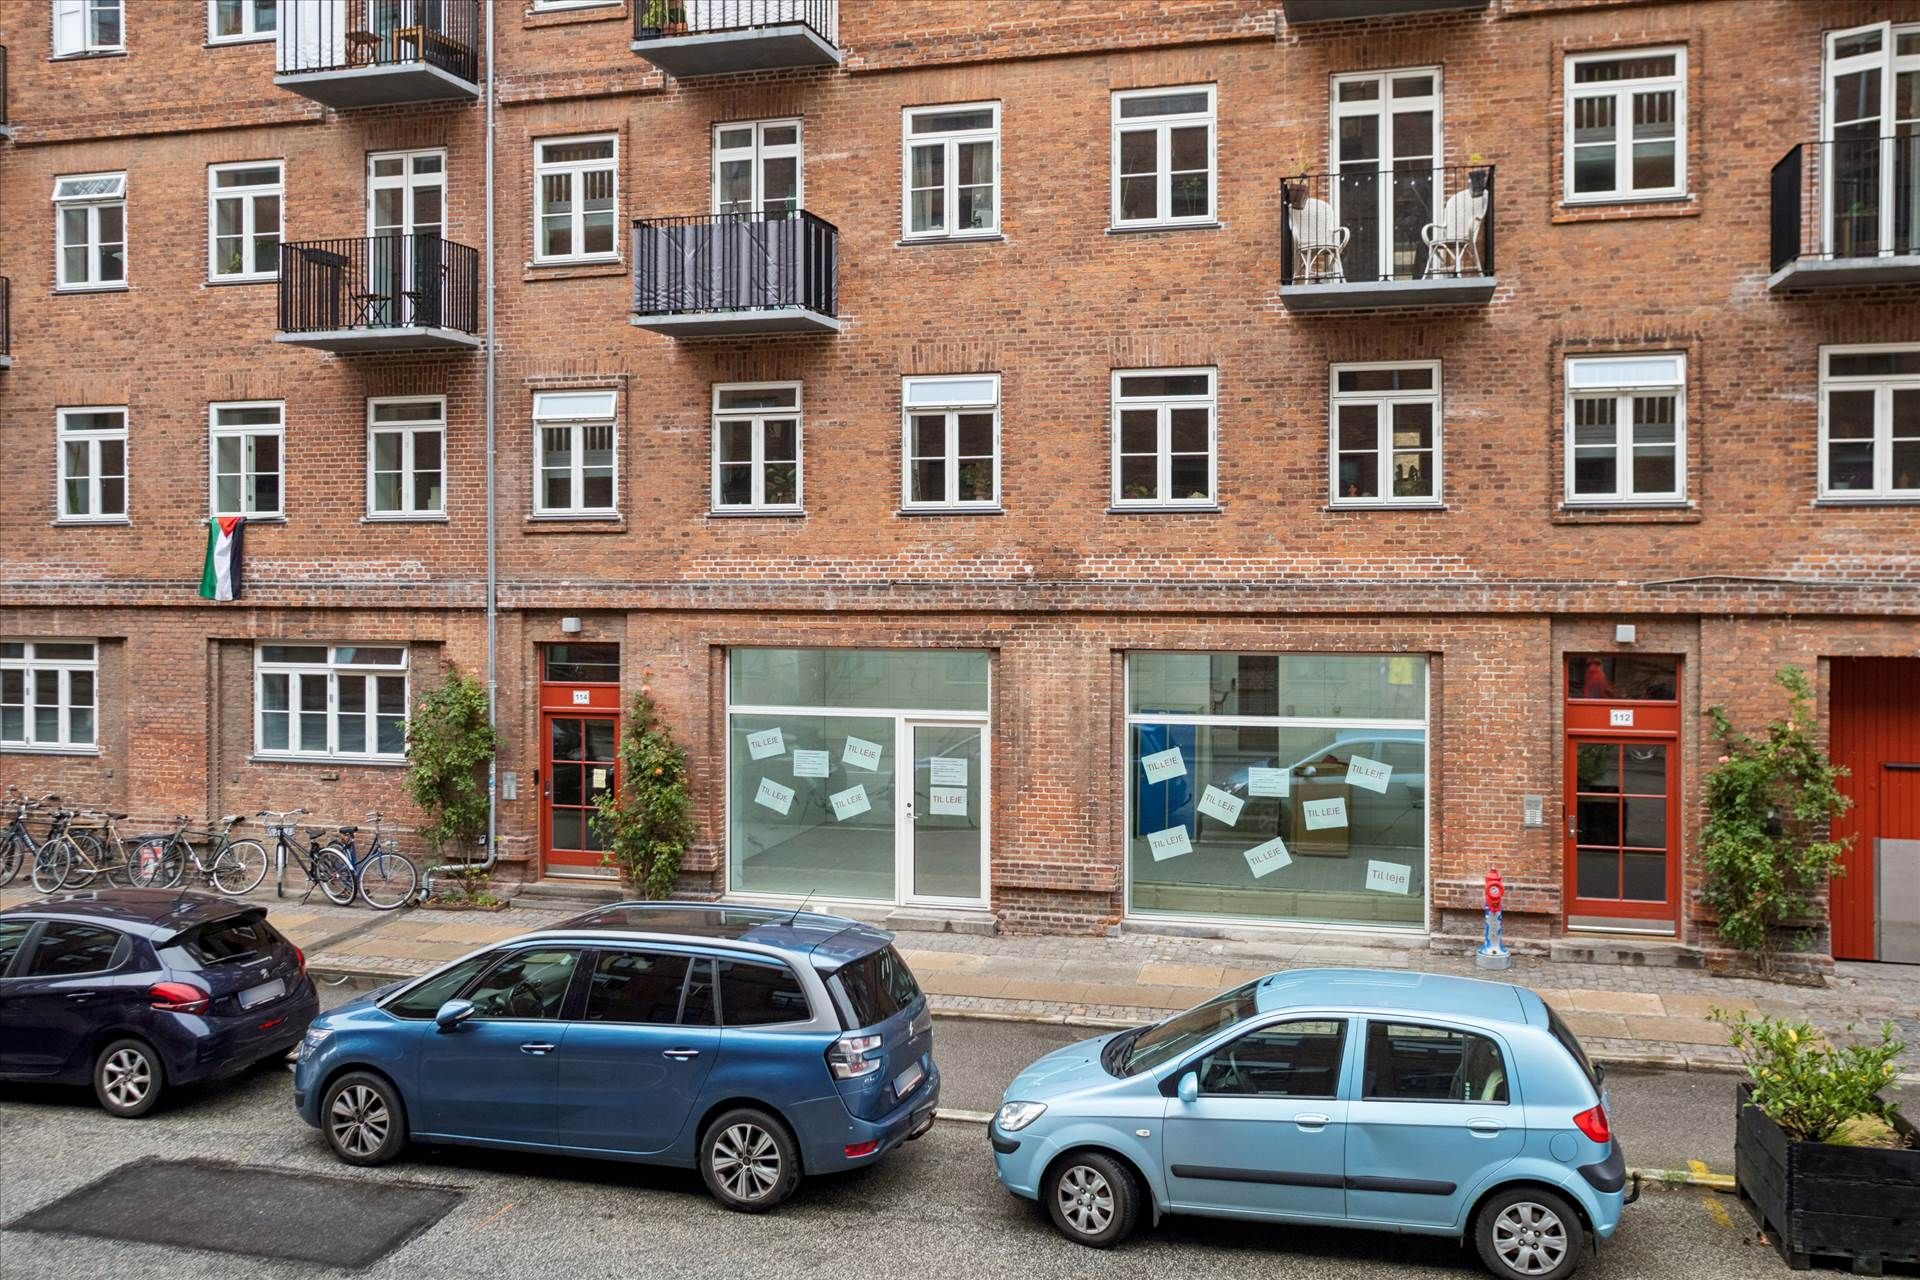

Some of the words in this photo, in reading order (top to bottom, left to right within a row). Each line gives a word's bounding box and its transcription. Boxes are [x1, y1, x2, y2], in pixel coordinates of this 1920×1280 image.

[763, 736, 778, 746] LEJE
[848, 744, 858, 754] TIL
[860, 748, 876, 758] LEJE
[1148, 763, 1159, 771] TIL
[1160, 756, 1177, 768] LEJE
[1352, 764, 1363, 774] TIL
[1365, 768, 1384, 780] LEJE
[762, 786, 772, 795] TIL
[772, 790, 788, 801] LEJE
[835, 800, 845, 808] TIL
[846, 793, 864, 804] LEJE
[933, 796, 944, 804] TIL
[946, 796, 962, 804] LEJE
[1206, 794, 1216, 804] TIL
[1218, 800, 1235, 813] LEJE
[1308, 809, 1320, 817] TIL
[1322, 807, 1340, 816] LEJE
[1153, 840, 1164, 848] TIL
[1166, 834, 1184, 846] LEJE
[1251, 856, 1264, 864] TIL
[1264, 848, 1281, 860] LEJE
[1373, 870, 1383, 880] Til
[1387, 872, 1405, 884] leje
